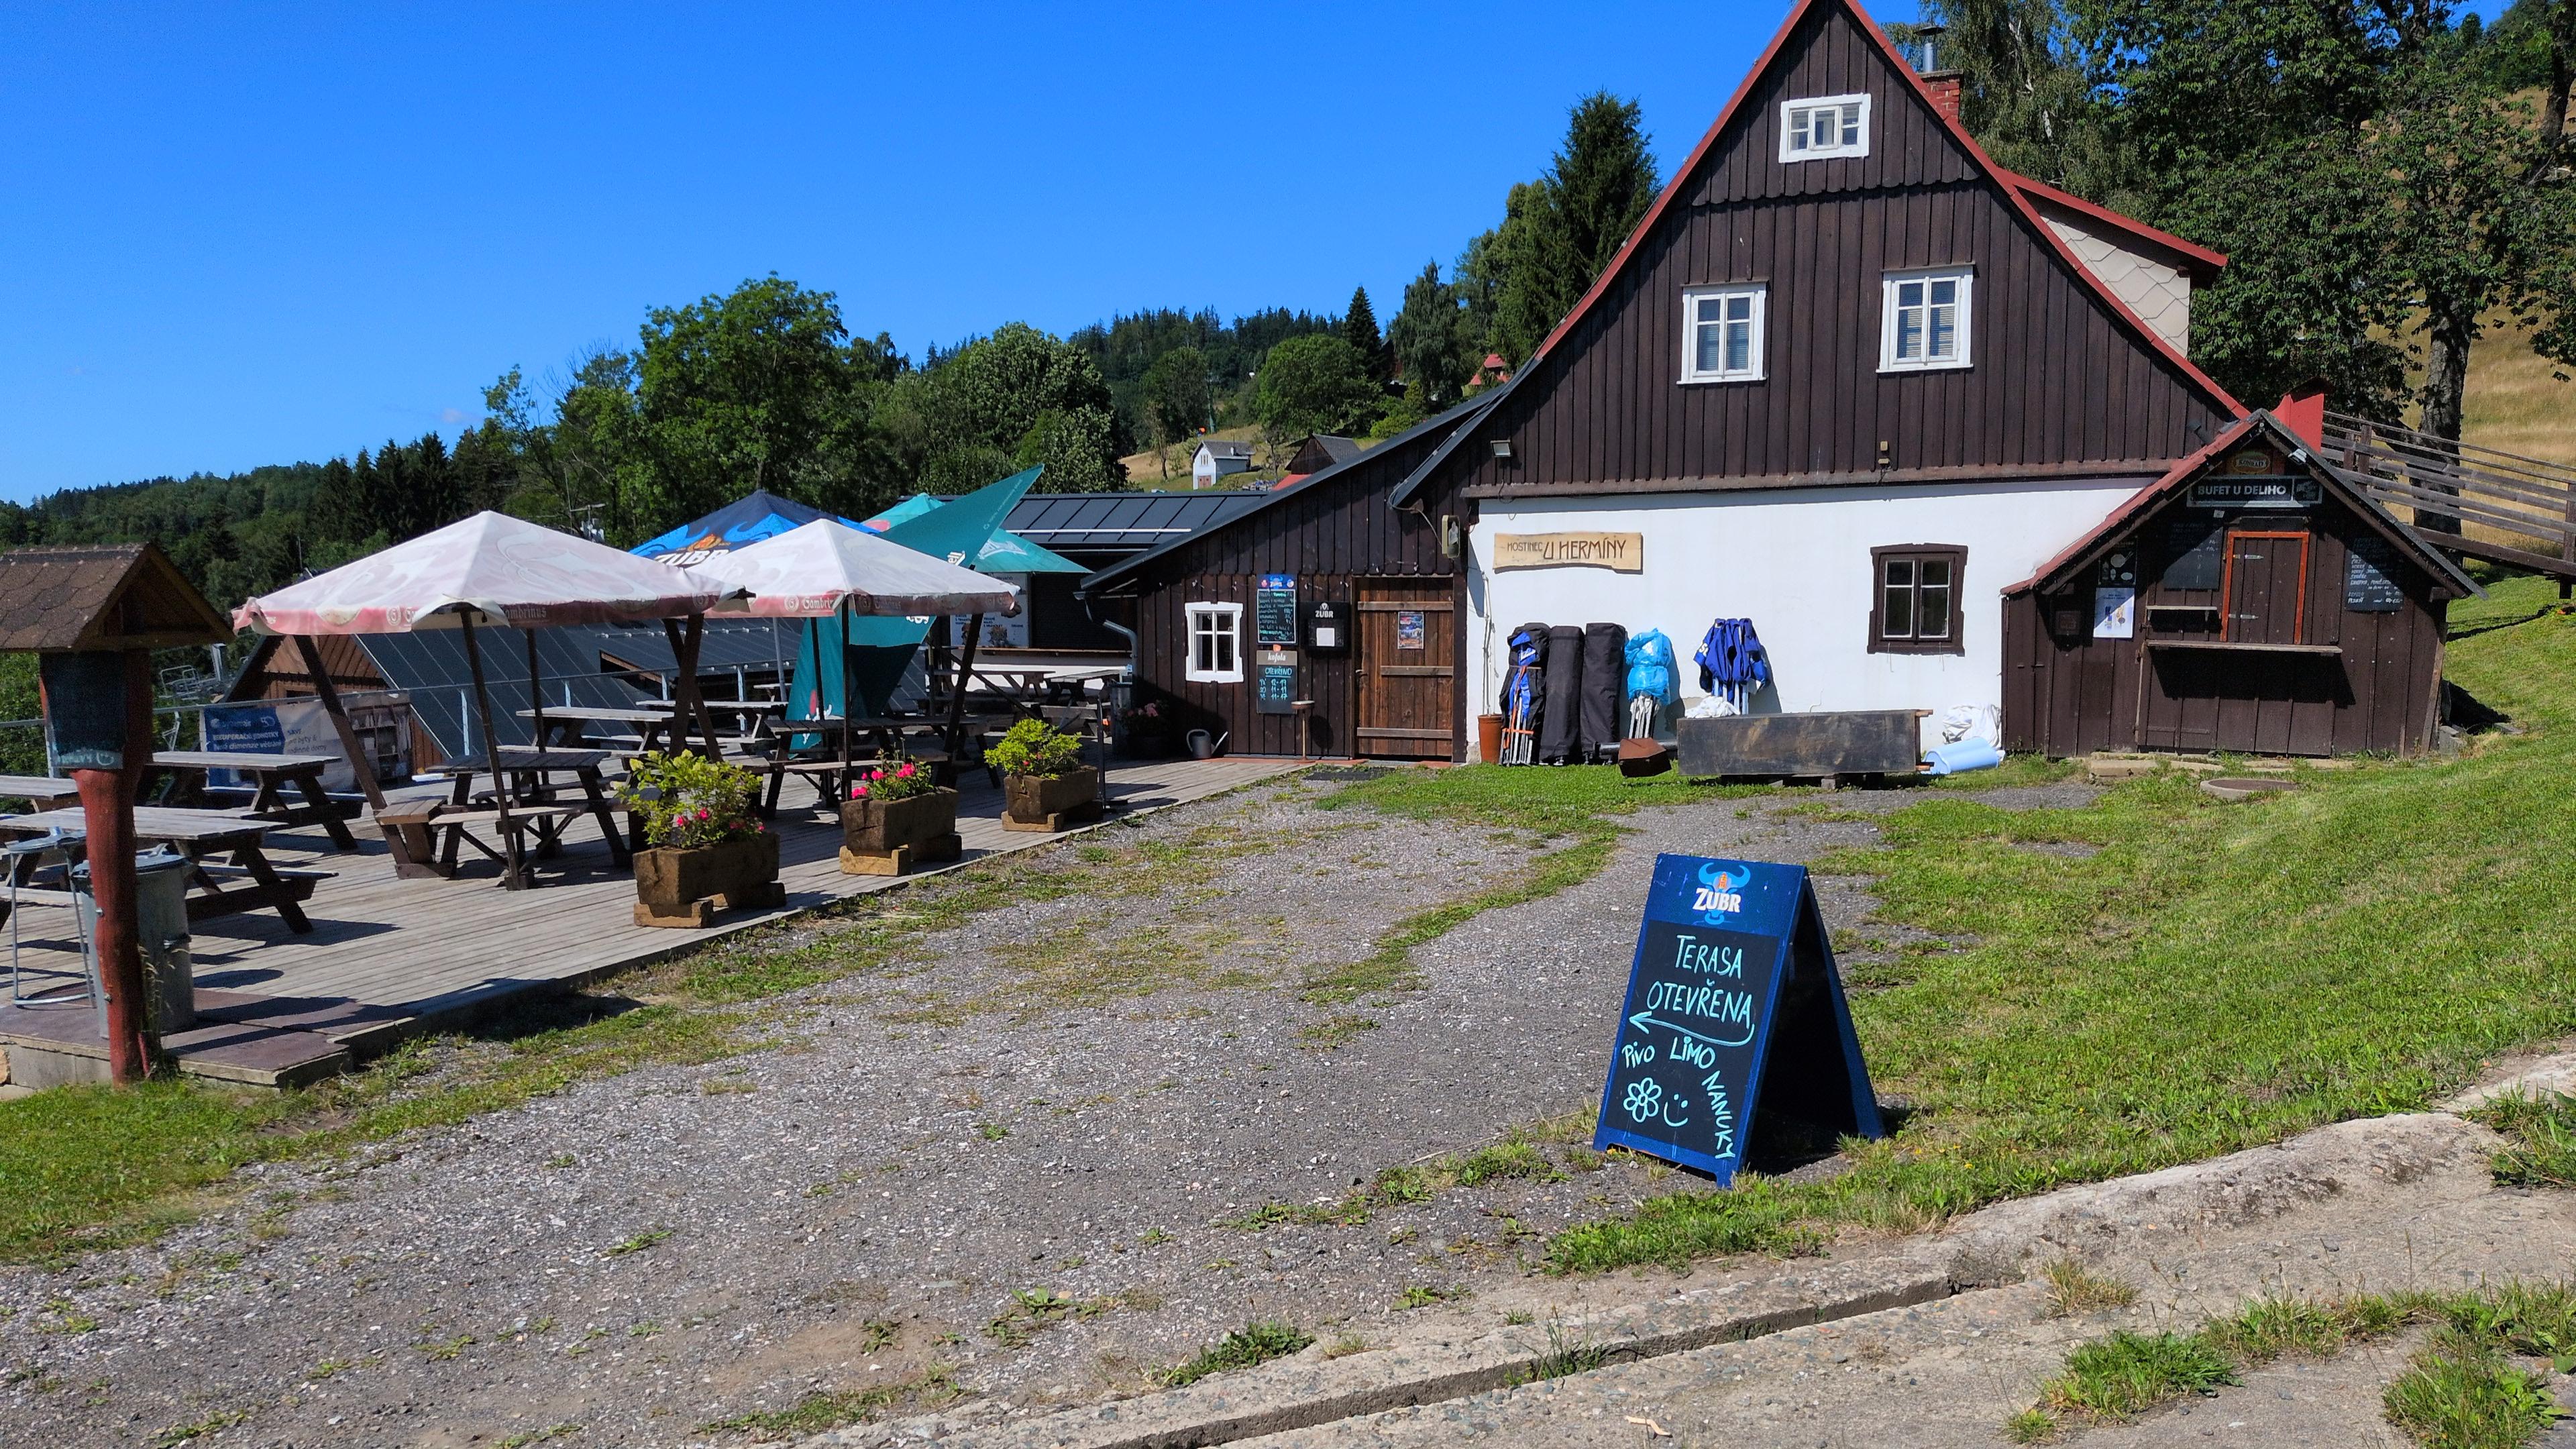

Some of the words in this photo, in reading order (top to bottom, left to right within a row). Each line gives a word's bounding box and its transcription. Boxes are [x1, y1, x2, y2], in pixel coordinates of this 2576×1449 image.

[2198, 485, 2231, 495] BUFET
[2233, 485, 2241, 495] U
[2244, 485, 2286, 495] DELIHO
[1507, 542, 1542, 551] HOSTINEC
[1544, 542, 1554, 559] U
[1559, 537, 1626, 559] HERMÍNY
[505, 605, 547, 619] ambrinus
[802, 597, 834, 610] Gambri
[1268, 653, 1286, 663] kofola
[1693, 887, 1741, 912] ZUBR
[1675, 934, 1742, 979] TERASA
[1647, 978, 1754, 1029] OTEVŘENA
[1701, 1070, 1736, 1160] NANUKY
